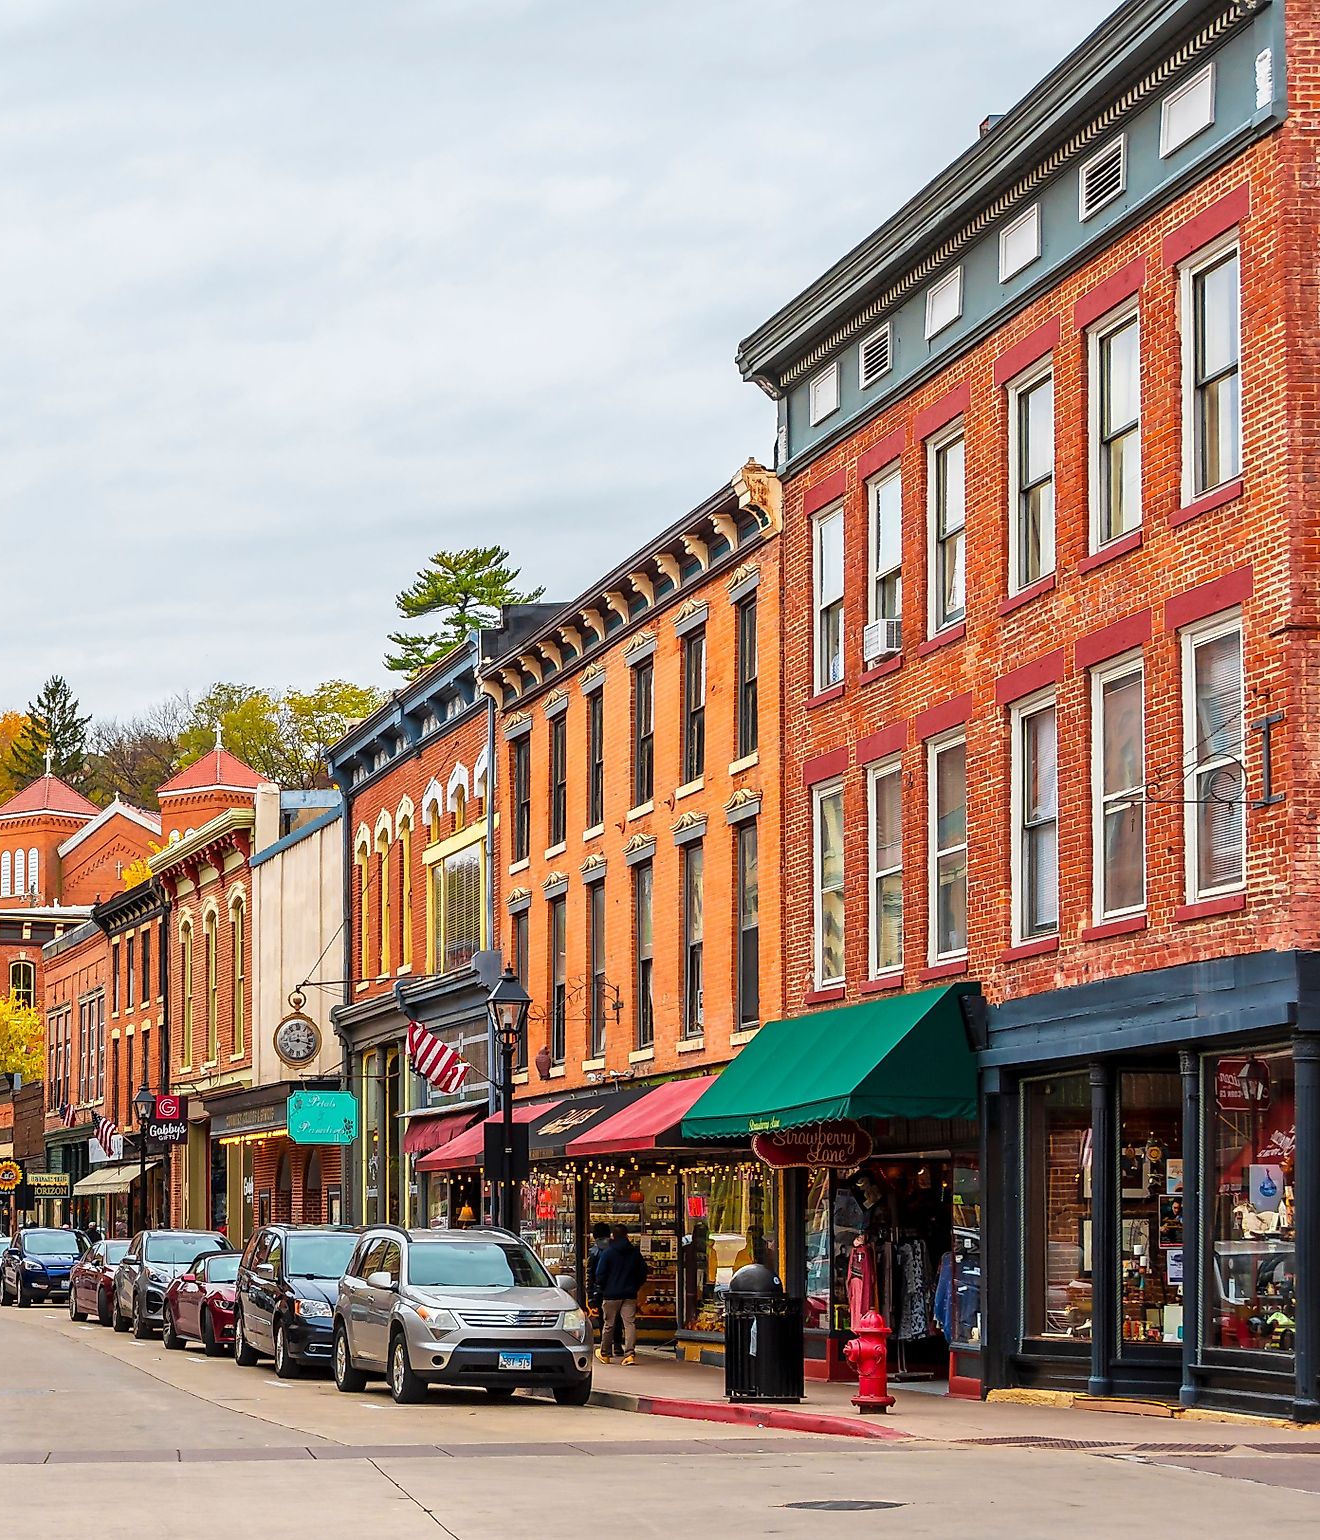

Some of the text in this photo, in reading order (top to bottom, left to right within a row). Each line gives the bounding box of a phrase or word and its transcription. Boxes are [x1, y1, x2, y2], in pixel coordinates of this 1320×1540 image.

[149, 1122, 187, 1140] Gabby's
[772, 1126, 856, 1154] Strawberry
[806, 1141, 847, 1162] Lane
